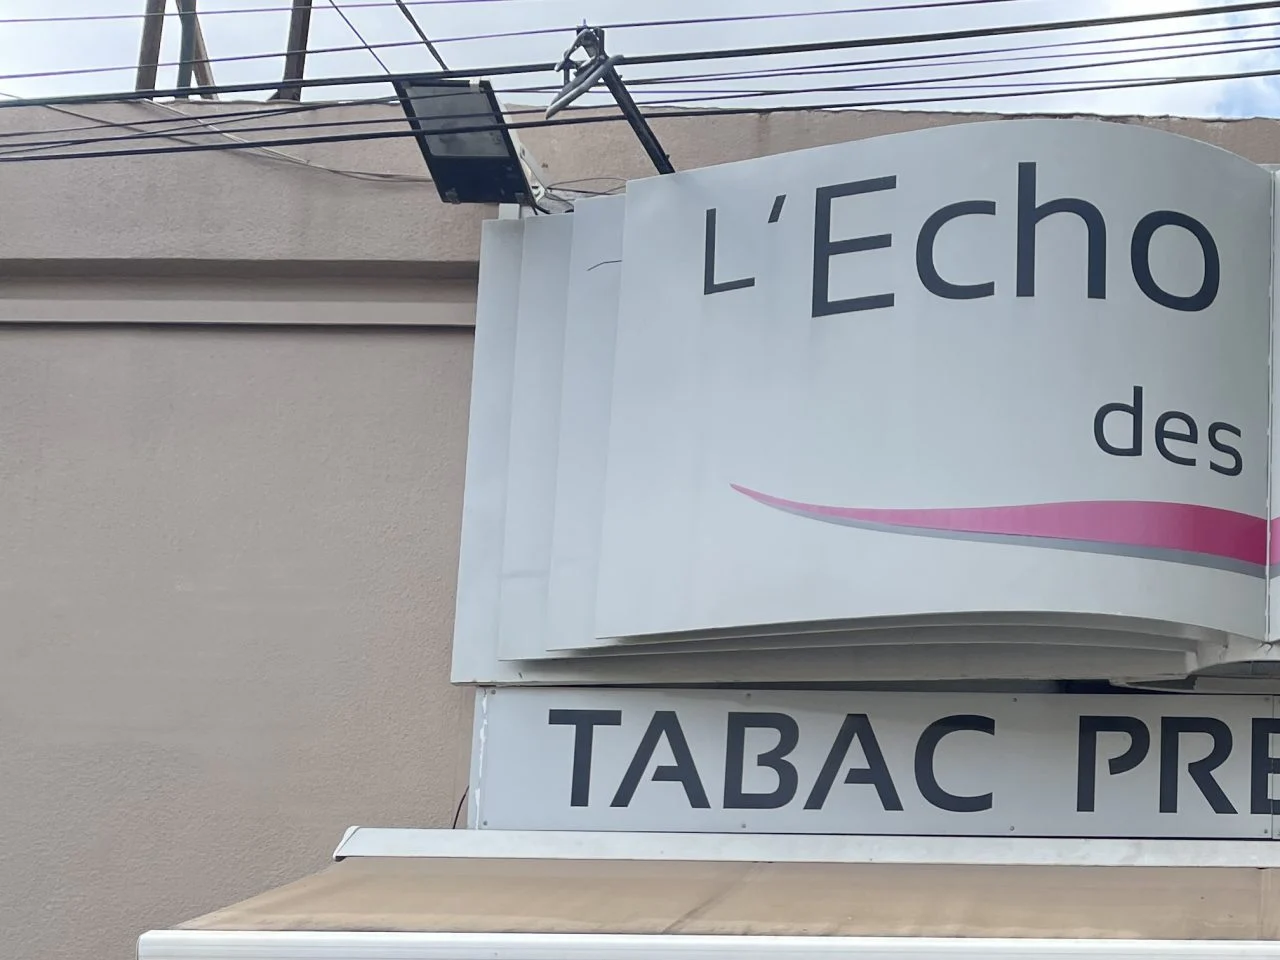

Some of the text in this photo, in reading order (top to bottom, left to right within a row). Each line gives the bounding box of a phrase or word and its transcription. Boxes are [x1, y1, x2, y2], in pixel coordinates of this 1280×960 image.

[703, 161, 1221, 319] L'Echo
[1093, 385, 1244, 477] des
[548, 708, 996, 813] TABAC
